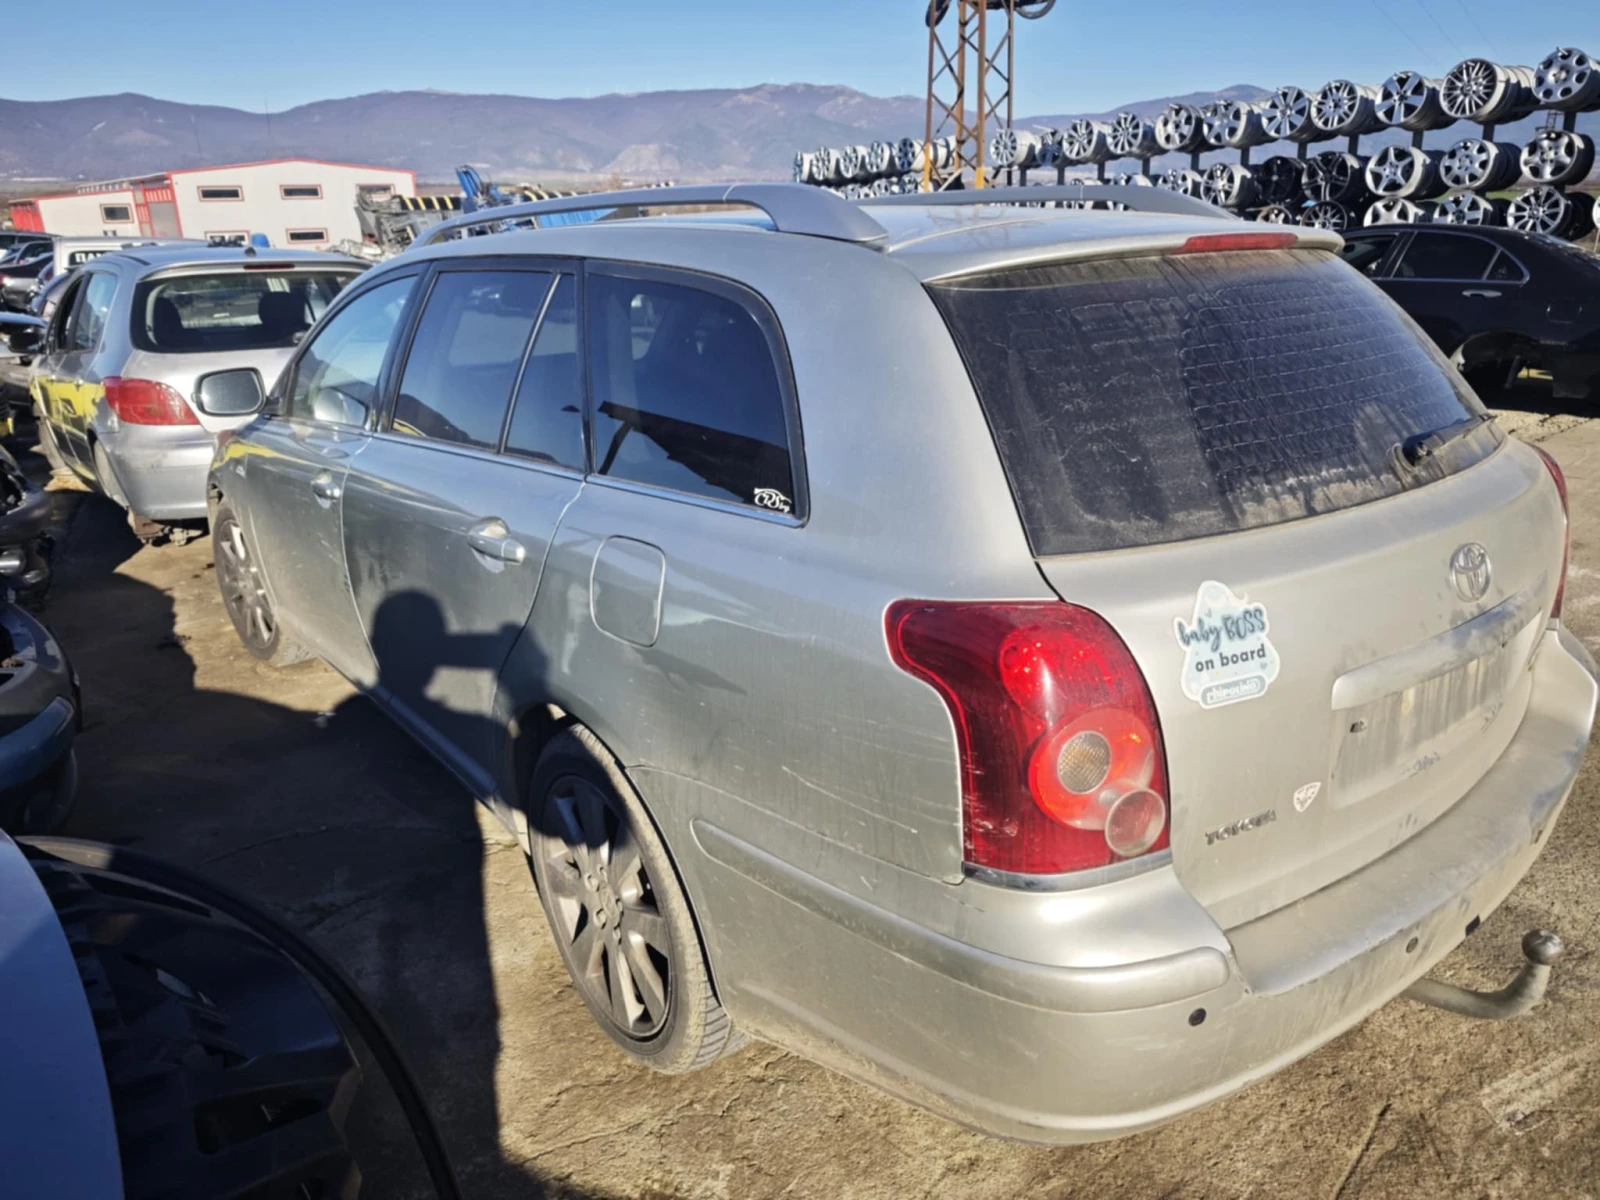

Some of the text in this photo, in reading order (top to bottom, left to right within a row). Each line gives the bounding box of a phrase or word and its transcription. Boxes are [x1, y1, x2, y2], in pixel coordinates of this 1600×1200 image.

[1177, 606, 1266, 653] baby BOSS
[1195, 643, 1266, 672] on board
